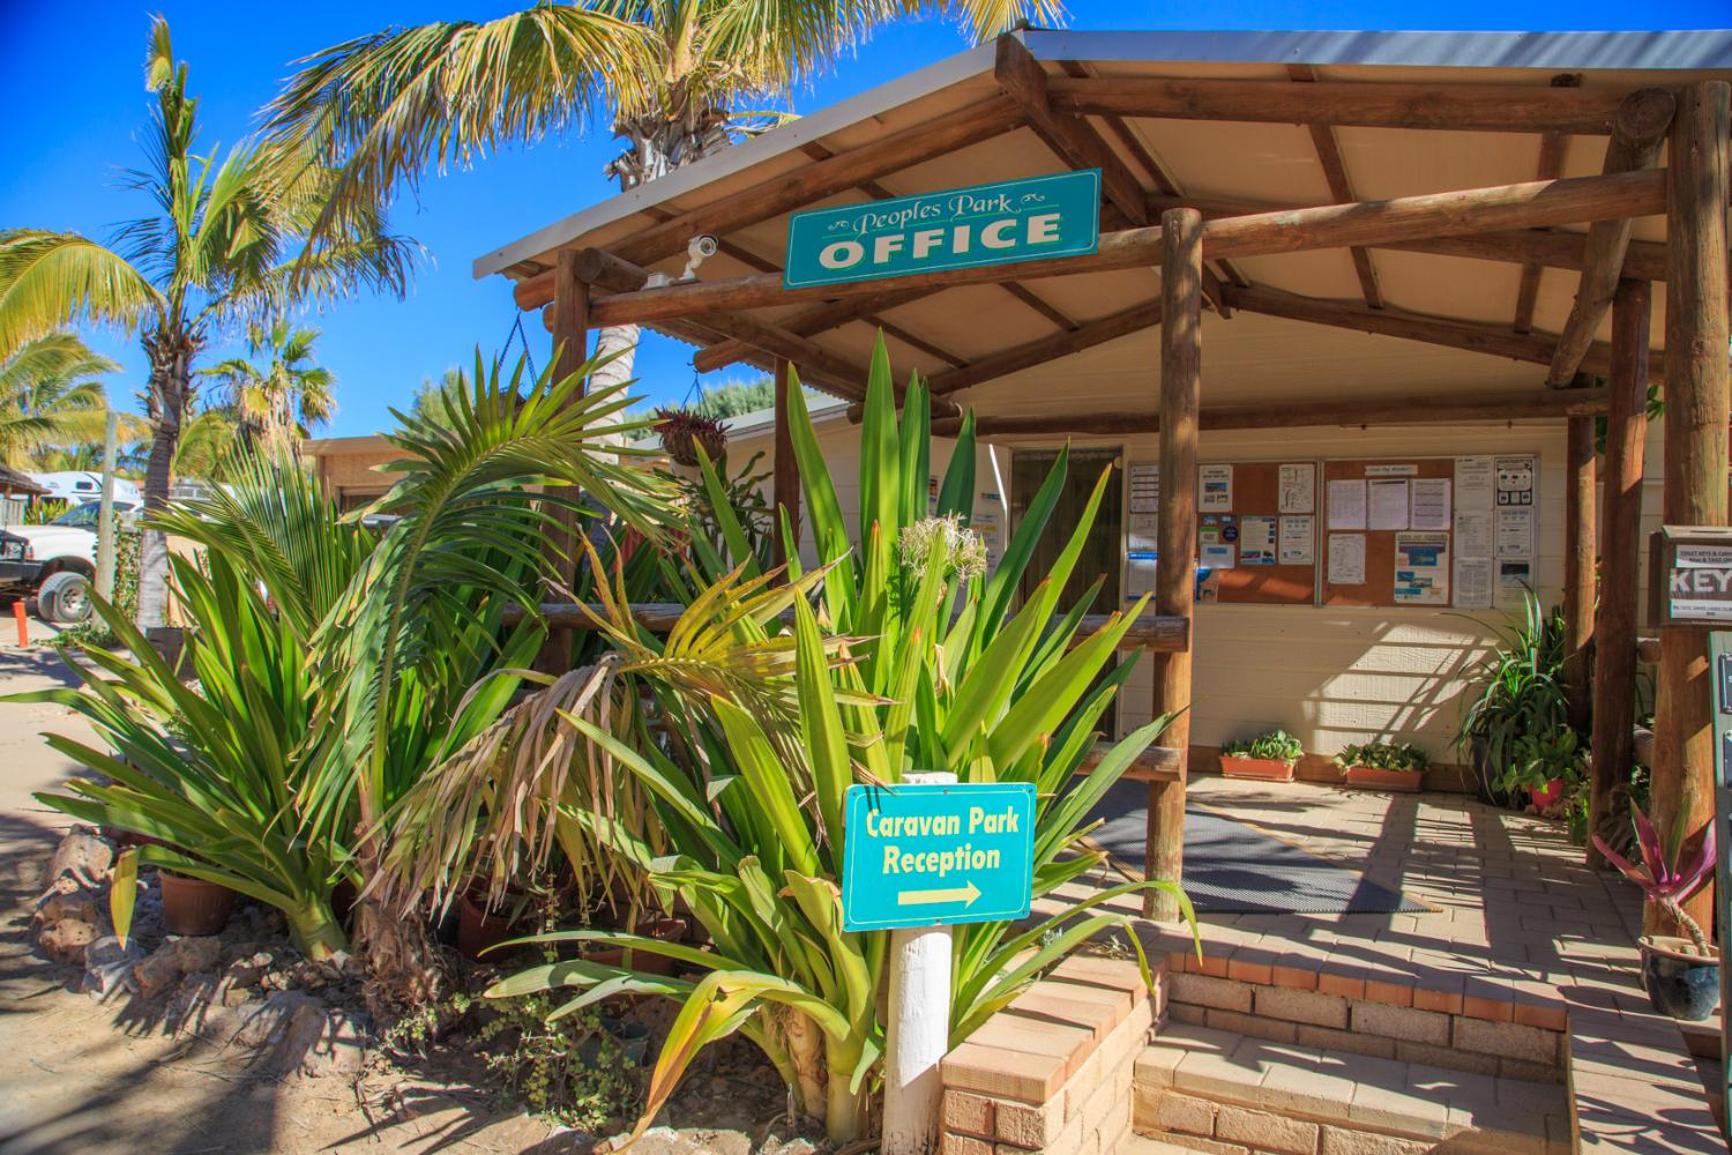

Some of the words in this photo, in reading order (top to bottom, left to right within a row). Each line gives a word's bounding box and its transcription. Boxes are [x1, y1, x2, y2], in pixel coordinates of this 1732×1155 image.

[853, 200, 942, 239] Peoples
[948, 194, 1022, 222] Park
[819, 213, 1062, 269] OFFICE
[866, 808, 961, 838] Caravan
[968, 806, 1020, 835] Park
[882, 843, 1001, 878] Reception
